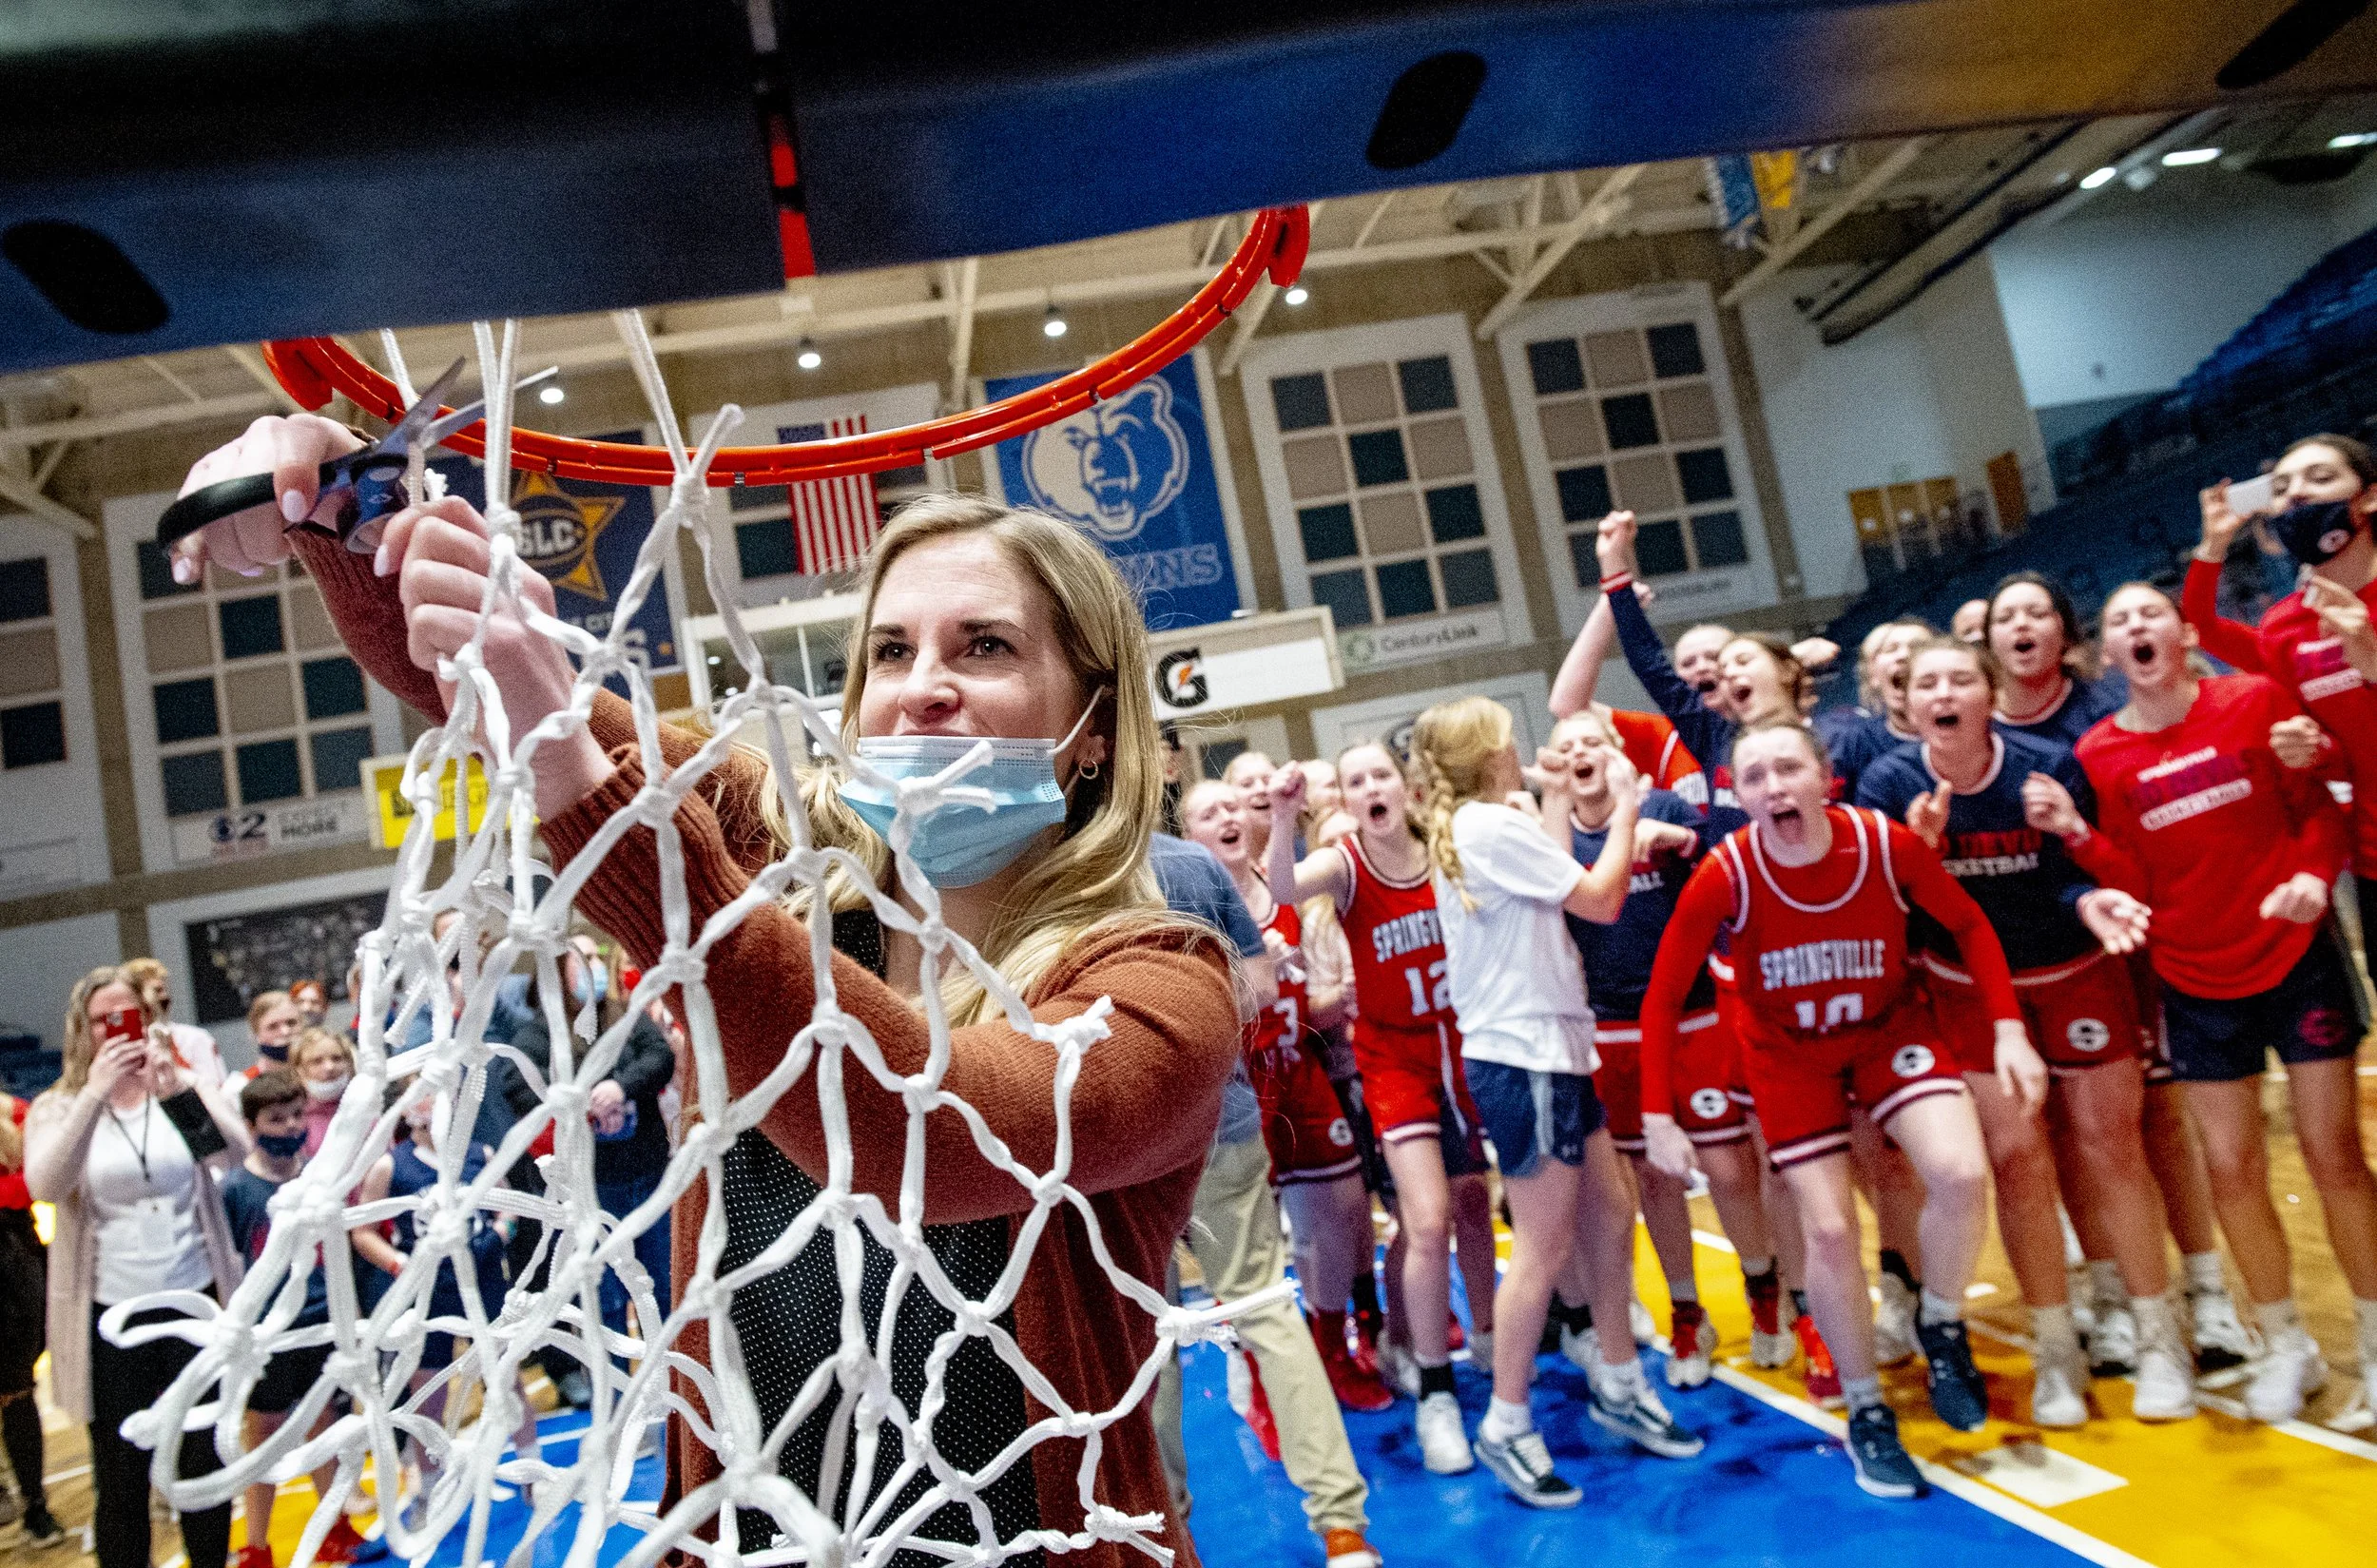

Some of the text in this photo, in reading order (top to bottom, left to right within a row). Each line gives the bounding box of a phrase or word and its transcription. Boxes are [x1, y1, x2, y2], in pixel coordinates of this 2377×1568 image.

[1154, 647, 1209, 708] G
[240, 811, 267, 840] 2
[1404, 959, 1450, 1016] 12
[1759, 938, 1885, 991] SPRINGVILLE
